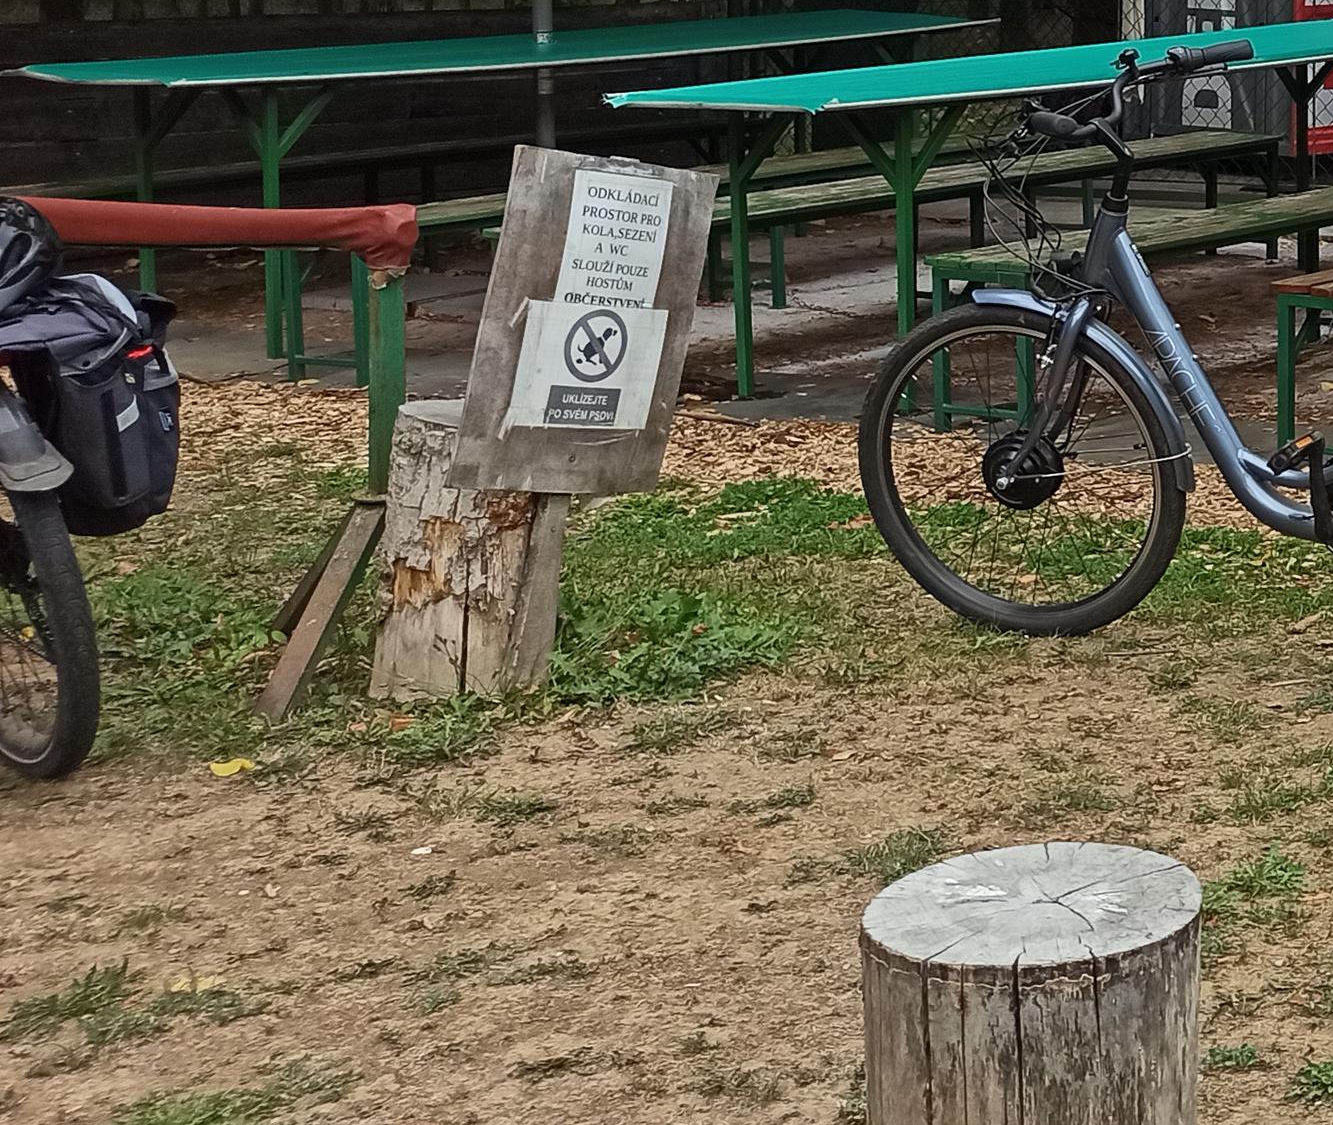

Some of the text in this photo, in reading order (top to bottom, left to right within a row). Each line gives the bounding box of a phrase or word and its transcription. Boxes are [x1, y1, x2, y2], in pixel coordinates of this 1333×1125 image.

[587, 186, 660, 207] ODKLÁDACÍ
[582, 205, 662, 227] PROSTOR PRO
[594, 242, 629, 257] A WC
[571, 258, 649, 278] SLOUŽÍ POUZE
[586, 276, 633, 291] HOSTŮM
[564, 292, 645, 309] OBČERSTVENÍ
[562, 393, 608, 405] UKLÍZEJTE
[548, 407, 614, 421] PO SVÉM PSOVI
